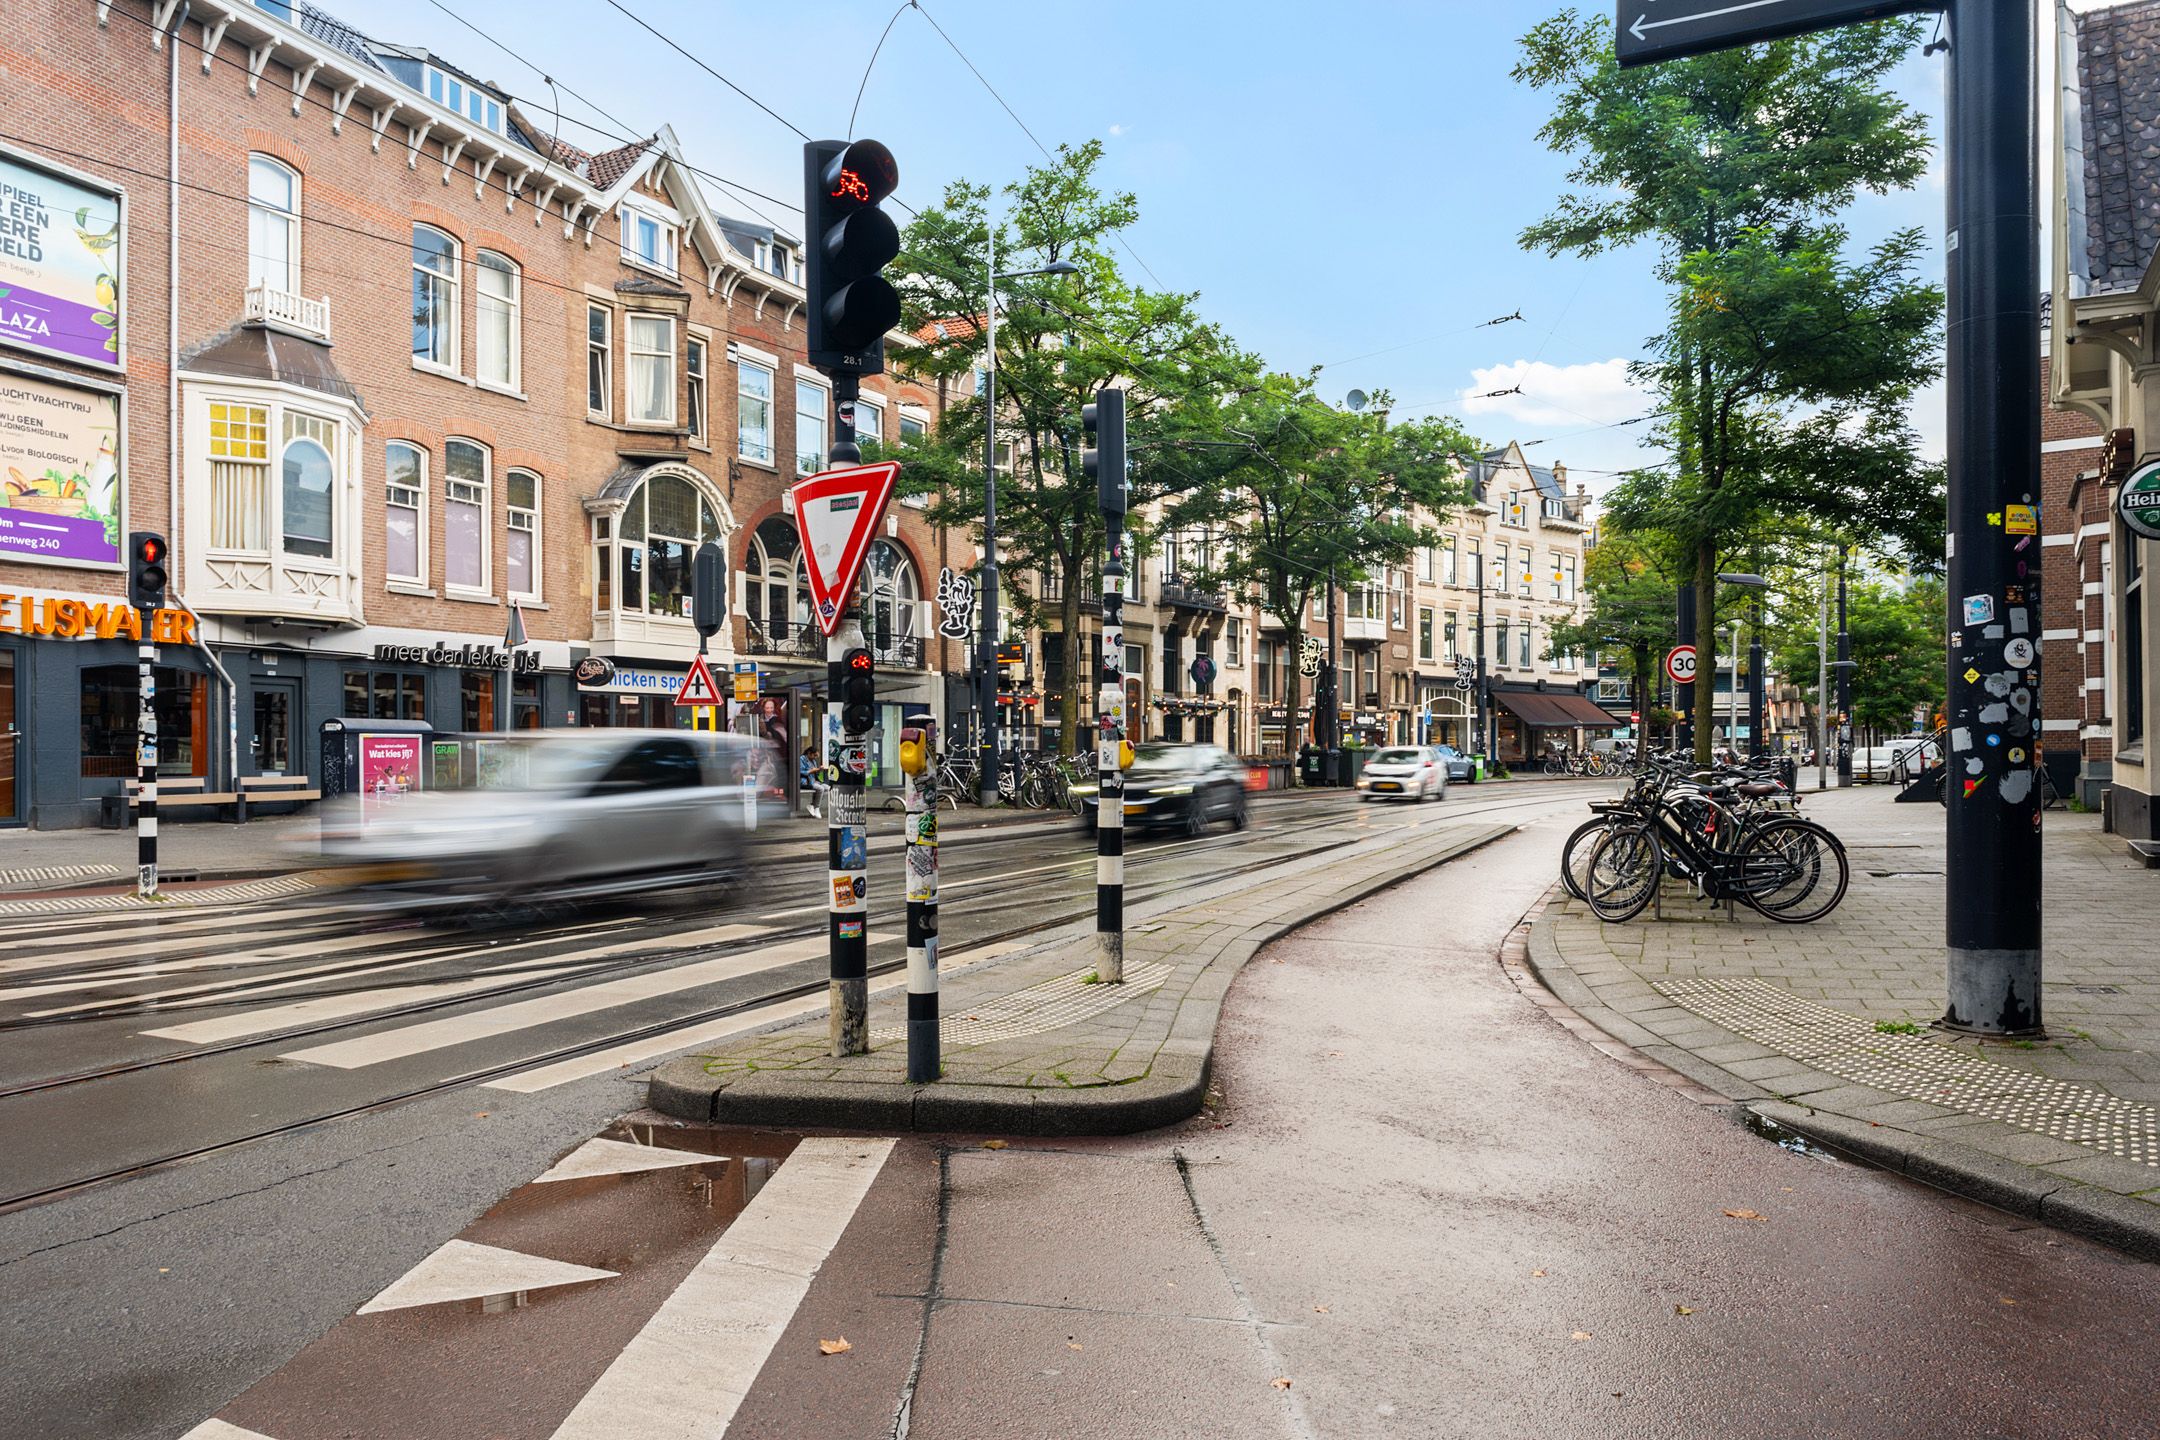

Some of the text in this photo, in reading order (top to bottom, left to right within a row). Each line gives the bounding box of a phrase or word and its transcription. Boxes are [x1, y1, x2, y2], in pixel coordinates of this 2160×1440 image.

[10, 201, 49, 229] EEN
[0, 234, 43, 264] ELD
[843, 355, 862, 366] 28.1
[17, 415, 44, 428] GEEN
[39, 537, 60, 550] 240
[380, 644, 427, 662] meer
[432, 641, 464, 664] dan
[467, 643, 513, 668] lekke
[1674, 657, 1696, 671] 30
[369, 749, 385, 759] Wat
[385, 748, 402, 758] kies
